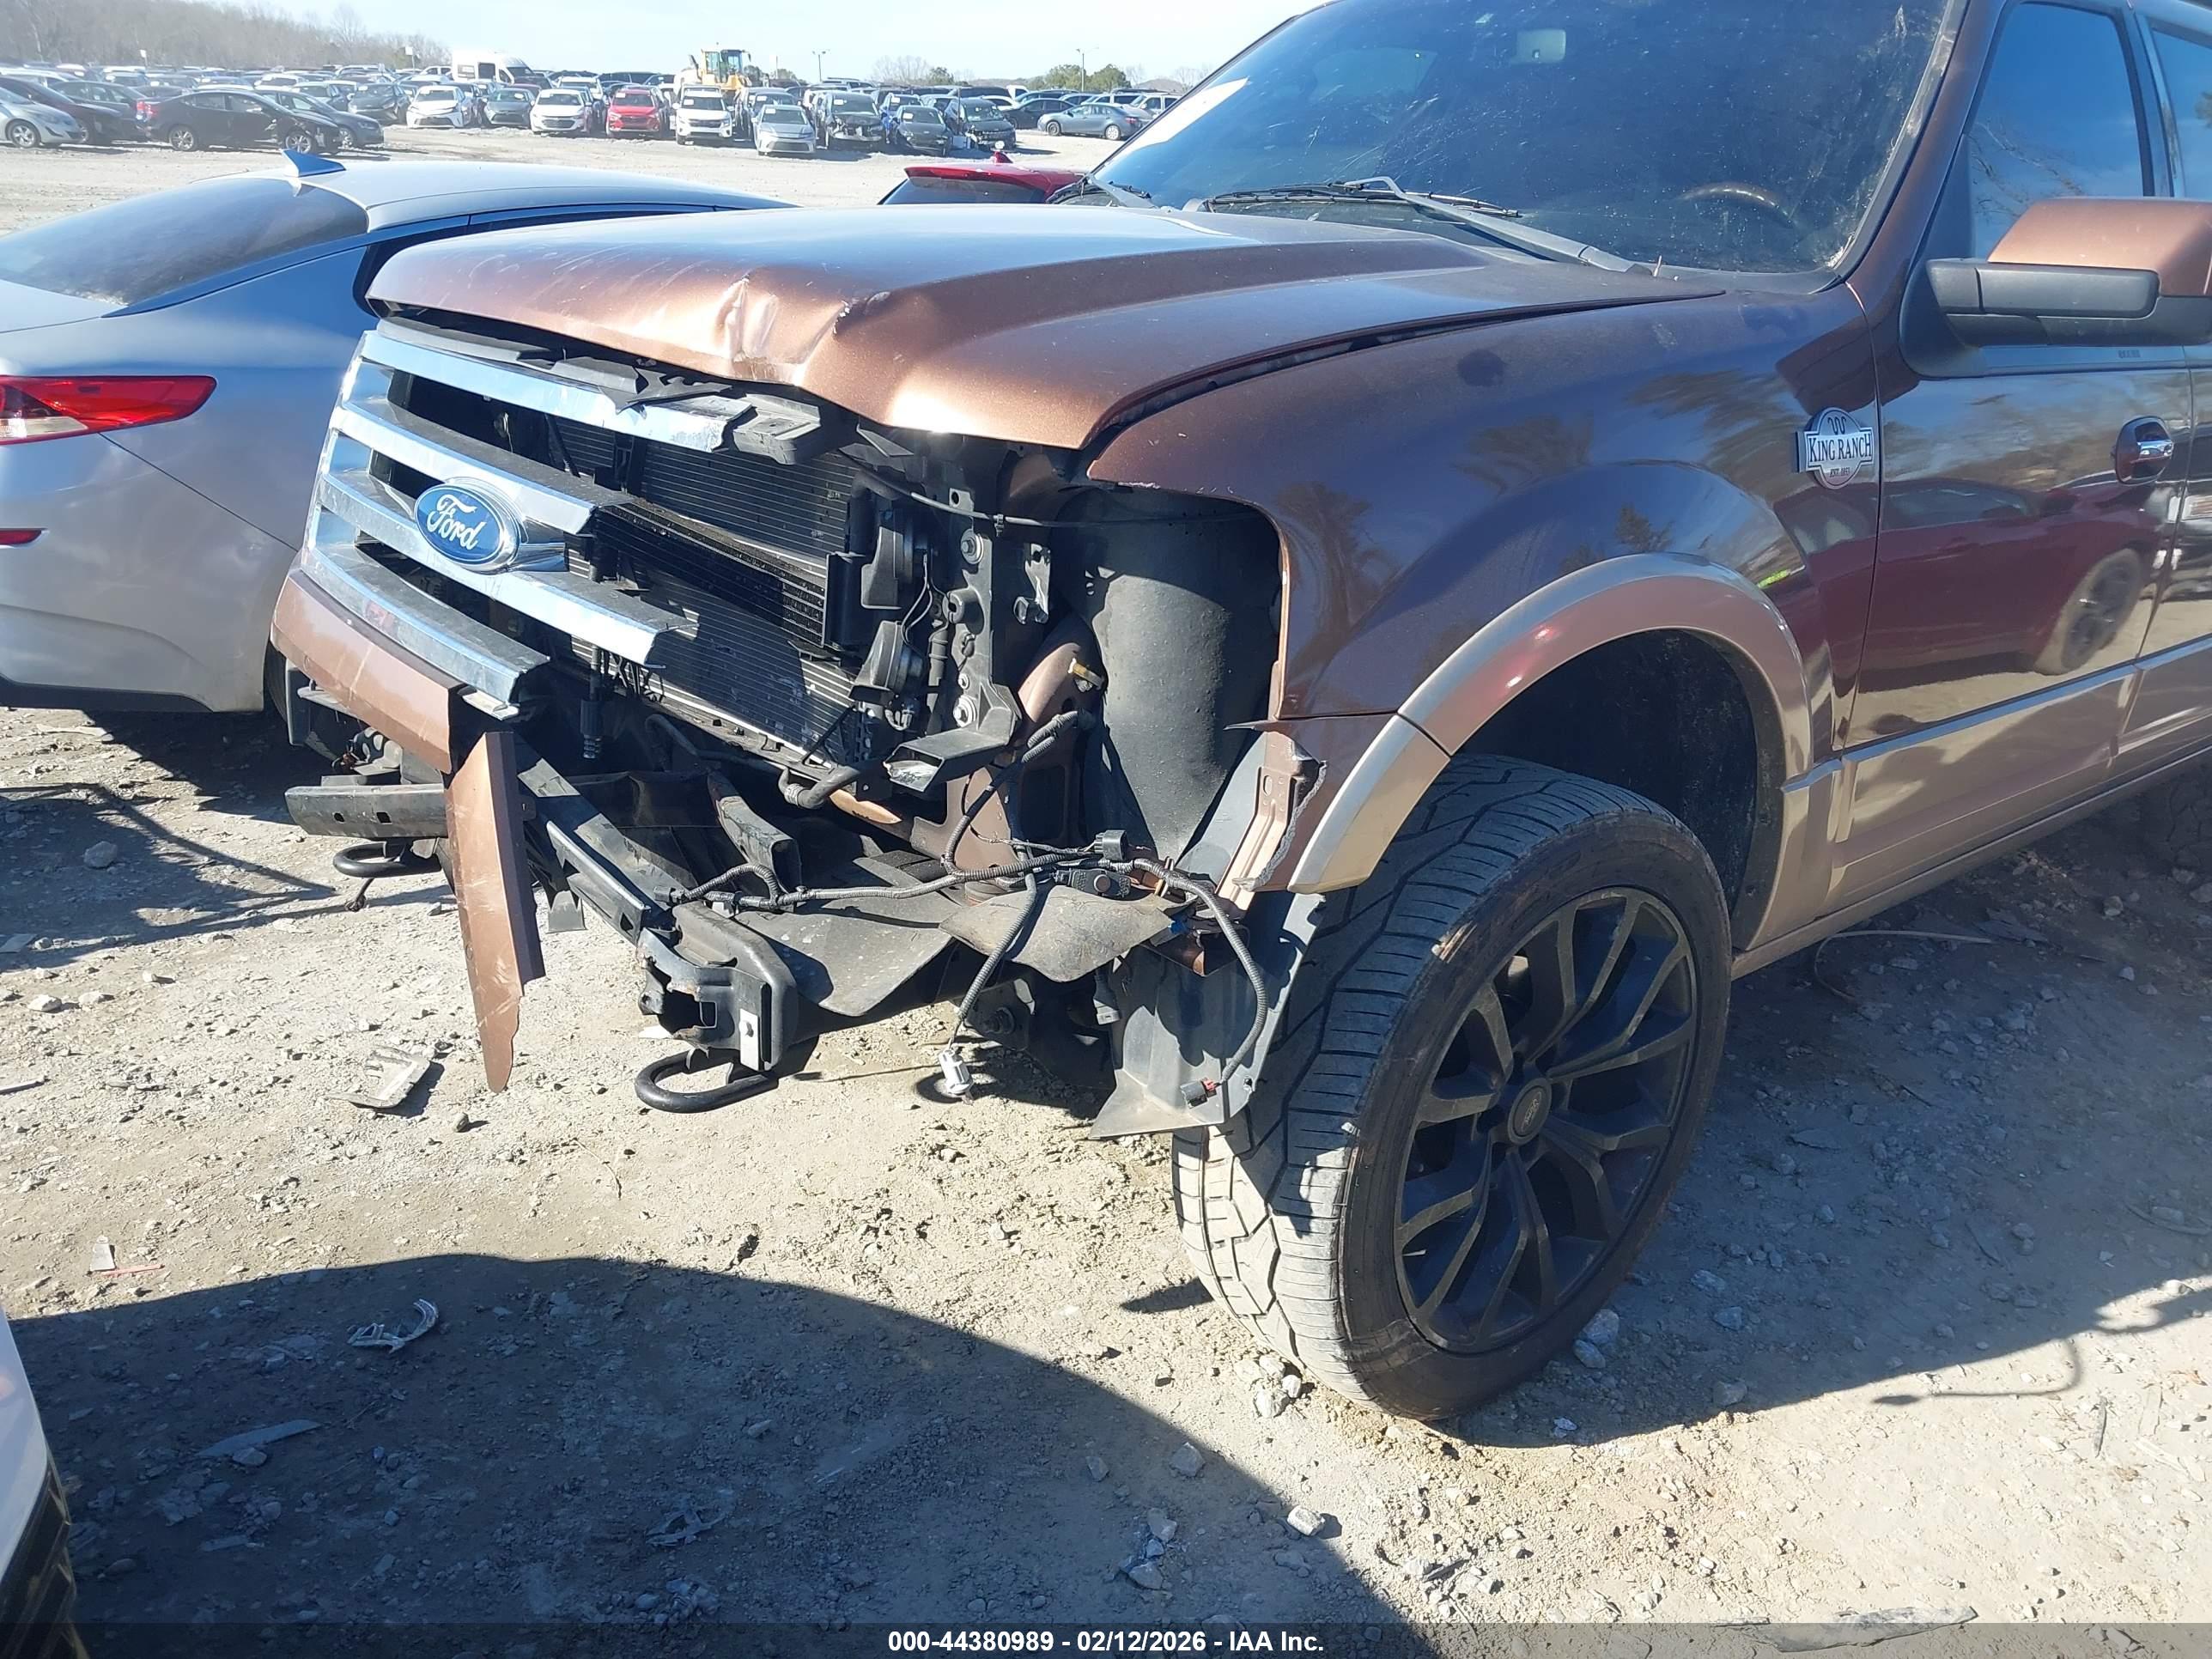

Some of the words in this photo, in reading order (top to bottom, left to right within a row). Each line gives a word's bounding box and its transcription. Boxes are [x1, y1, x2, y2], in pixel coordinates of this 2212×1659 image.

[1808, 437, 1836, 463] KING
[1838, 433, 1872, 460] RANCH
[427, 494, 488, 550] Ford
